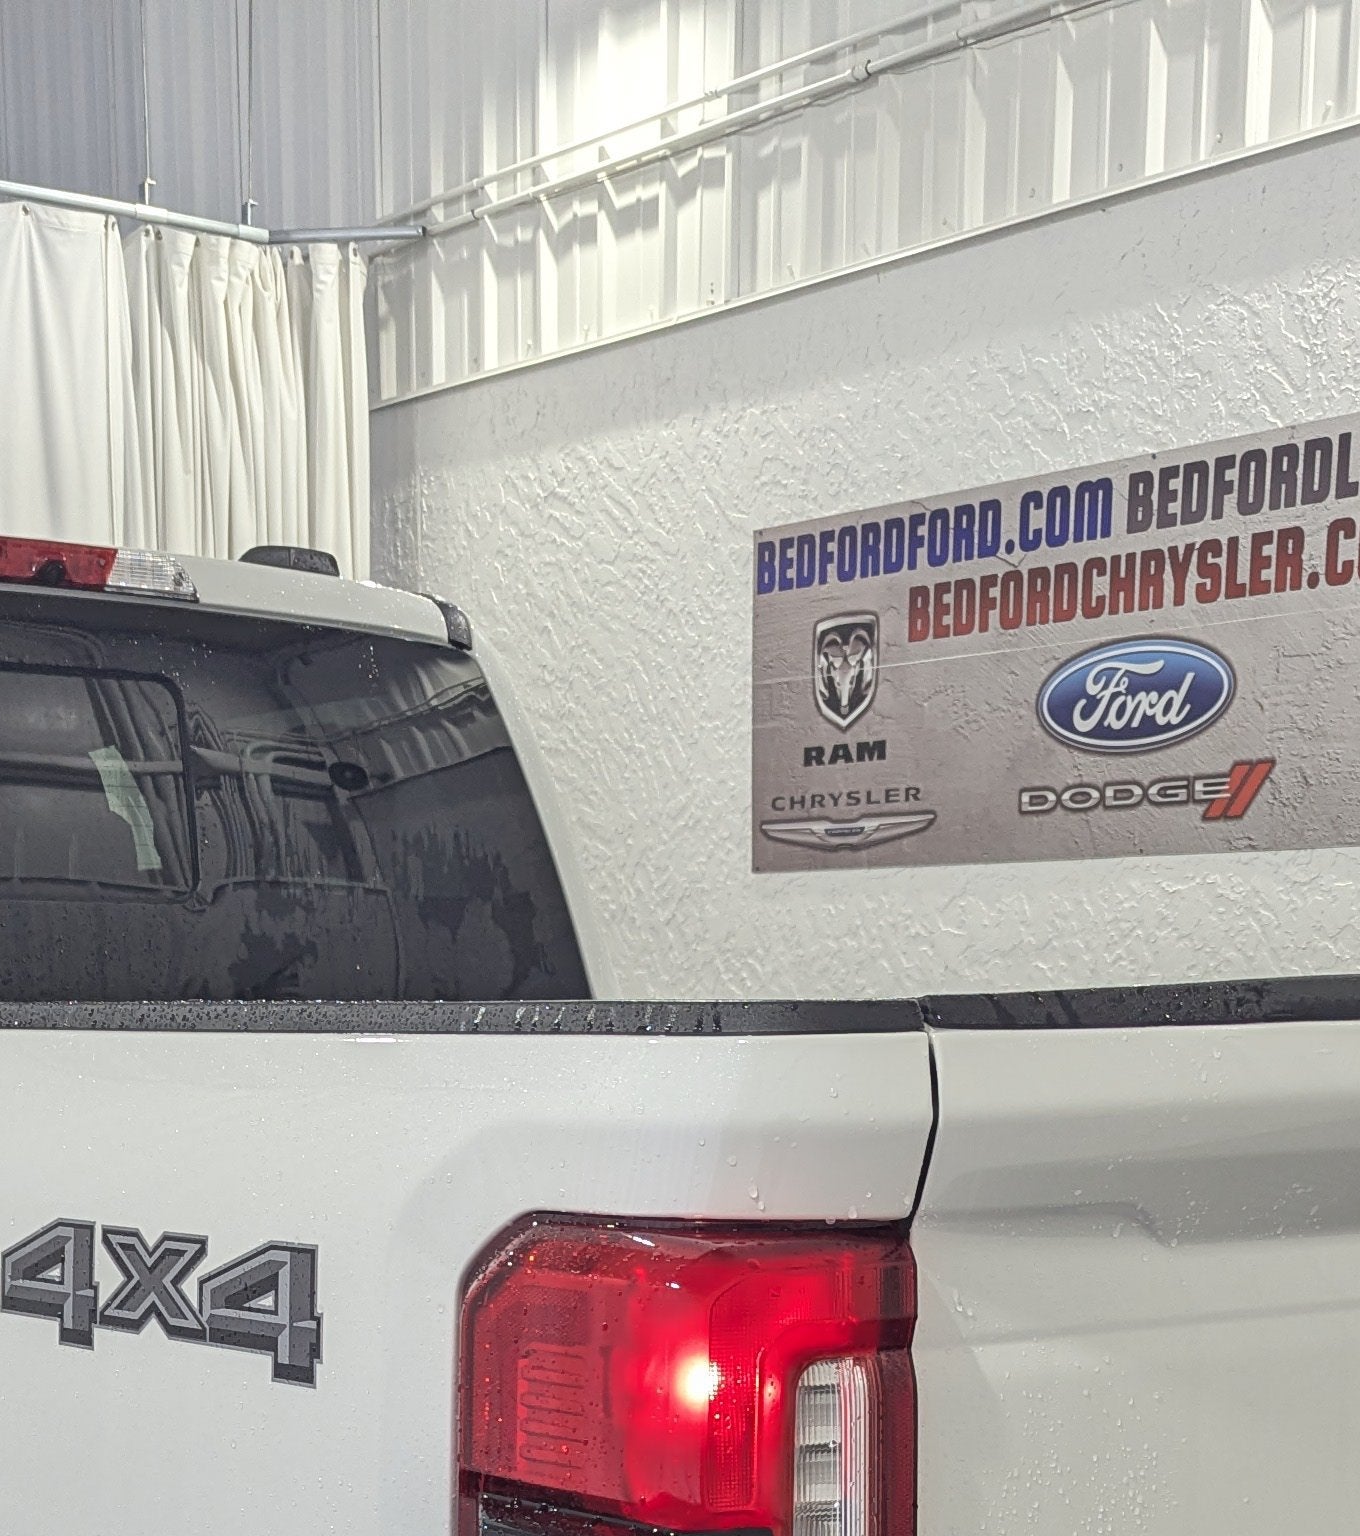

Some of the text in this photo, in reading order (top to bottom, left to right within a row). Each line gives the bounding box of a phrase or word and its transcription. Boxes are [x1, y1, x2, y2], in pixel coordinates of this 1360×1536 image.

[757, 477, 1114, 595] BEDFORDFORD.COM
[1072, 659, 1195, 733] Ford
[803, 740, 887, 767] RAM
[771, 786, 921, 812] CHRYSLER
[1019, 775, 1232, 813] DODGE
